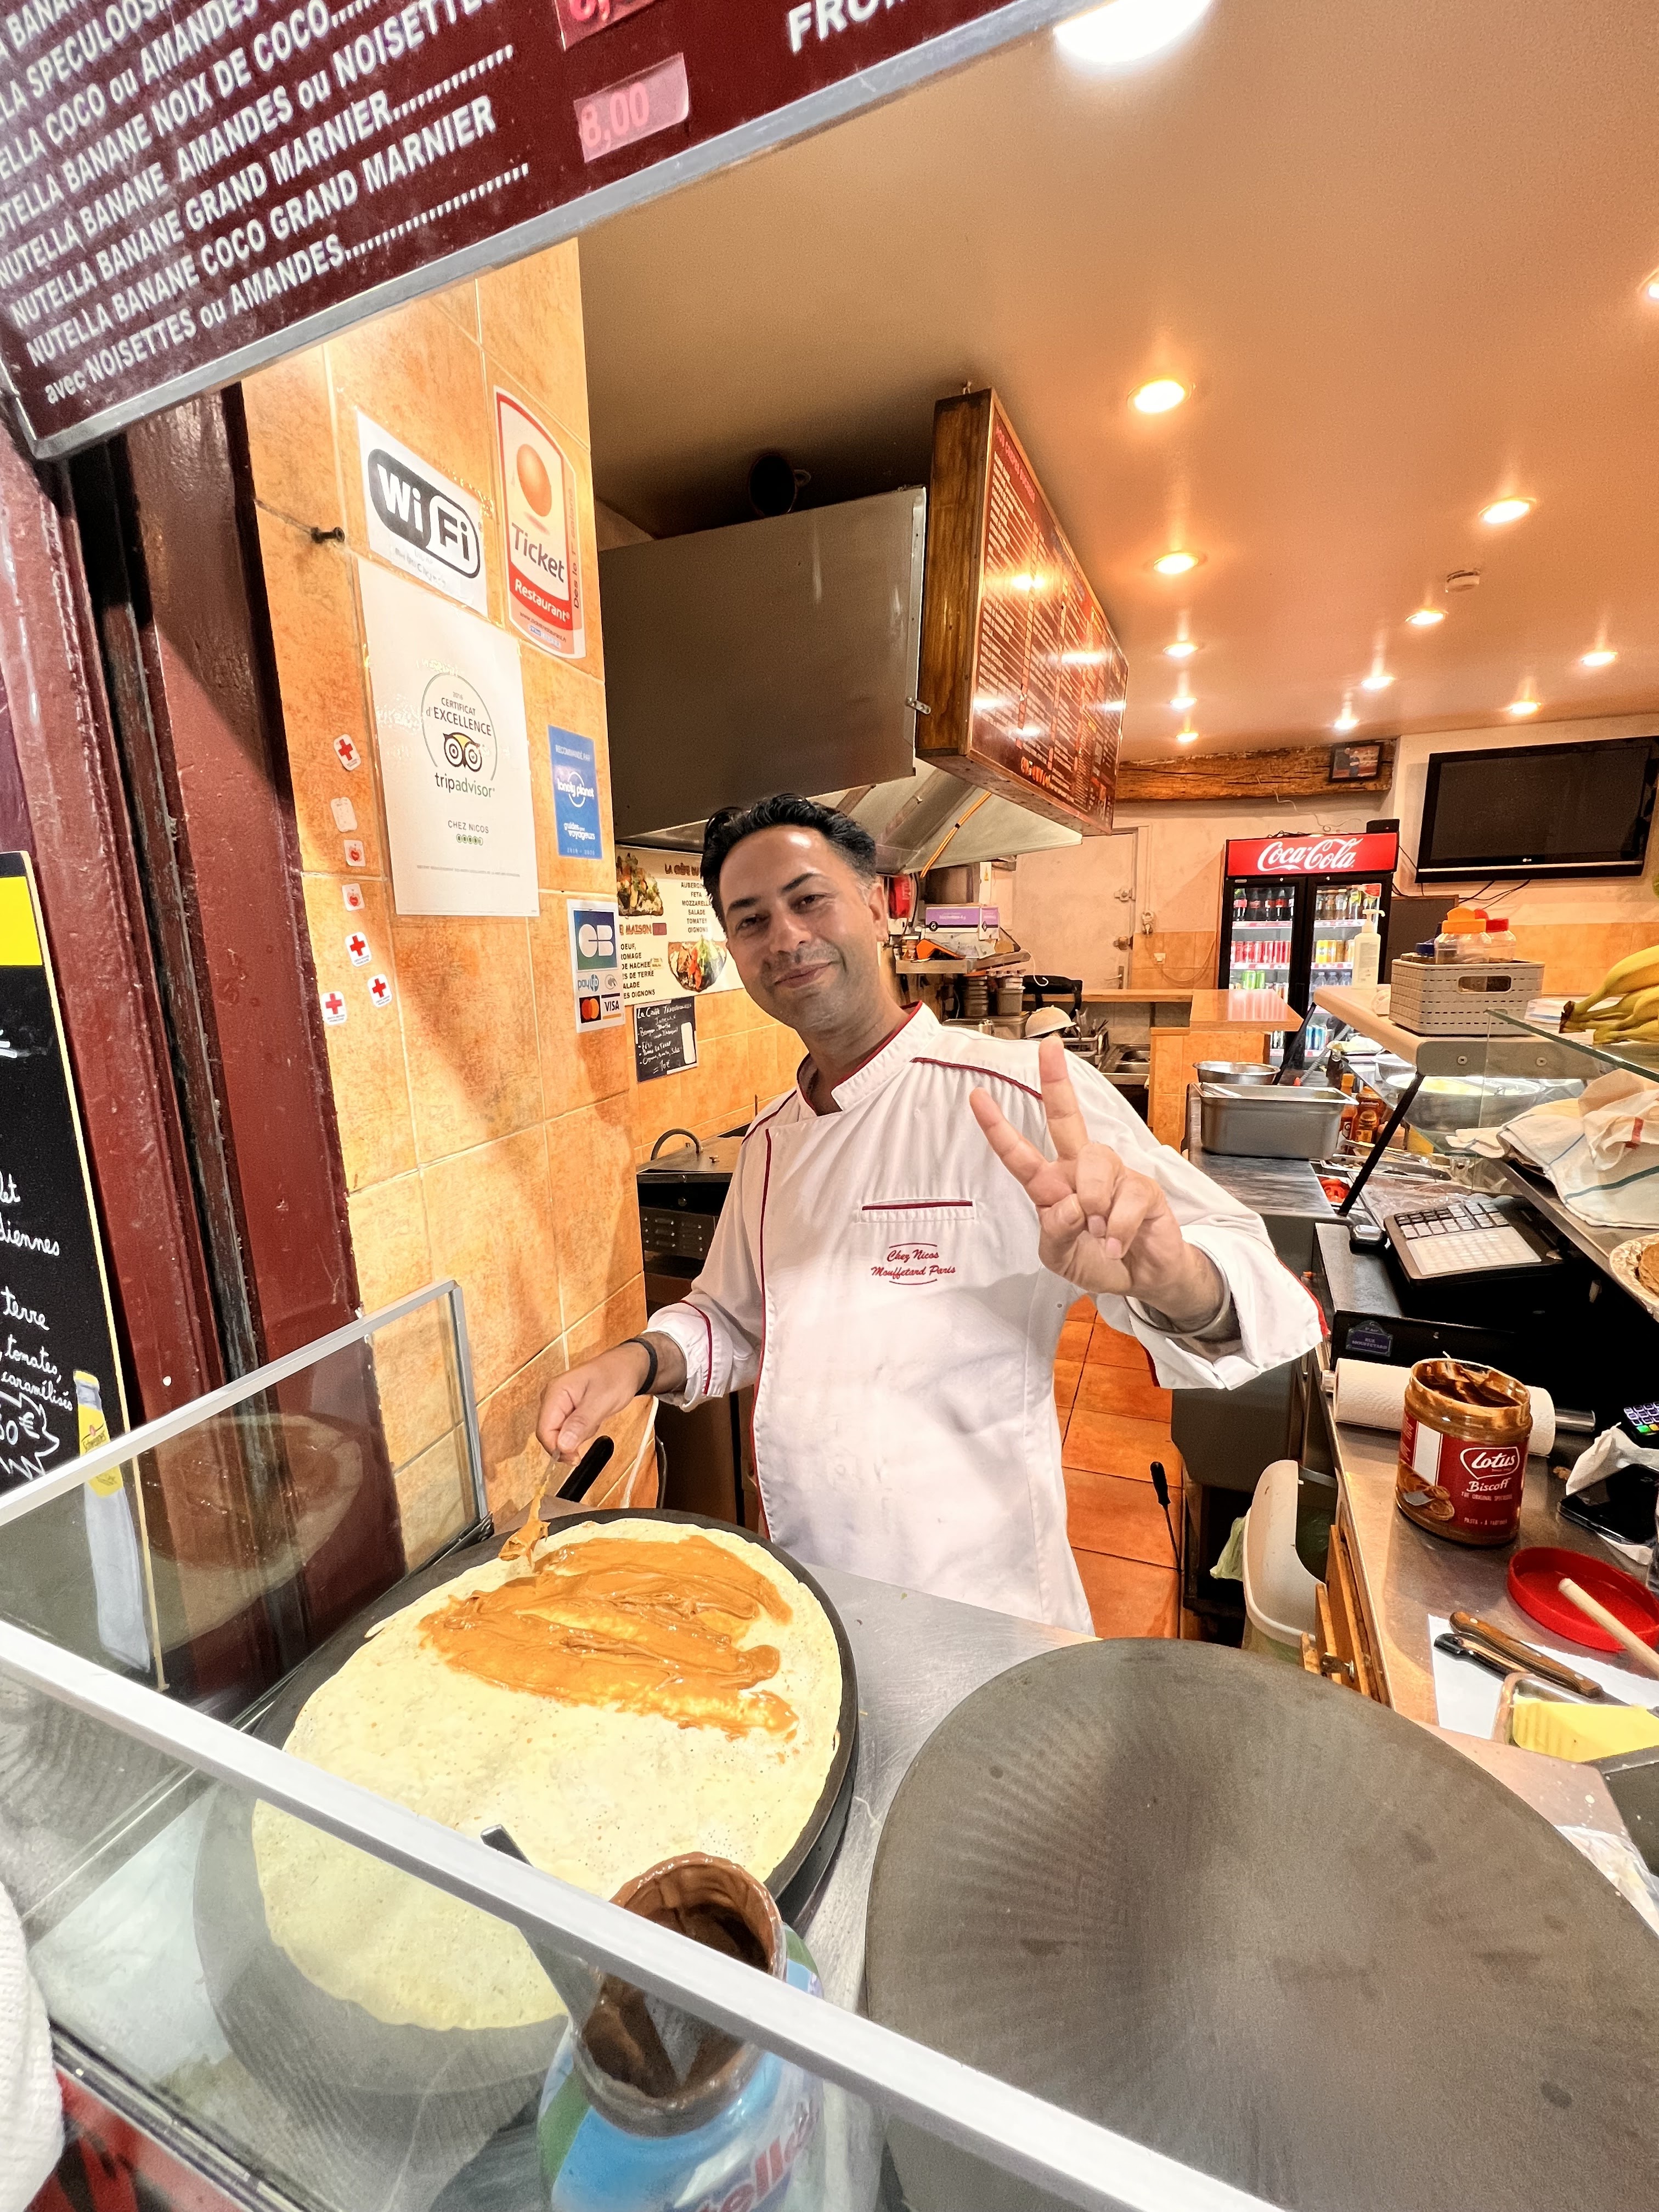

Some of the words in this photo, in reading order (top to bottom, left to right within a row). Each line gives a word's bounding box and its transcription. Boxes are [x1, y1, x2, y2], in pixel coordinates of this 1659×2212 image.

[46, 83, 107, 146] COCO
[110, 67, 138, 105] ou
[580, 81, 650, 151] 8,00
[61, 113, 153, 193] BANANE
[151, 72, 213, 137] NOIX
[213, 48, 252, 98] DE
[0, 218, 83, 289] NUTELLA
[79, 162, 168, 238] BANANE
[176, 85, 294, 182] AMANDES
[298, 70, 330, 110] ou
[26, 303, 114, 368] NUTELLA
[111, 255, 200, 323] BANANE
[200, 219, 267, 276] COCO
[269, 170, 359, 240] GRAND
[361, 95, 495, 194] MARNIER
[9, 261, 98, 329] NUTELLA
[97, 211, 185, 281] BANANE
[185, 162, 268, 232] GRAND
[44, 368, 87, 405] avec
[84, 309, 198, 385] NOISETTES
[199, 298, 227, 330] ou
[511, 522, 565, 584] Ticket
[441, 697, 476, 716] CERTIFICAT
[426, 706, 492, 736] d'EXCELLENCE
[435, 772, 493, 798] tripadvisor
[557, 777, 576, 798] lonely
[576, 783, 595, 799] planet
[448, 820, 467, 831] CHEZ
[469, 823, 489, 834] NICOS
[563, 821, 580, 831] guides
[568, 828, 596, 841] voyageurs
[1257, 837, 1364, 872] Coca-Cola
[625, 924, 652, 935] MAISON
[631, 989, 656, 998] OIGNONS
[603, 1000, 619, 1012] VISA
[887, 1249, 911, 1263] Chez
[912, 1249, 940, 1260] Nicos
[870, 1266, 926, 1280] Mouffetard
[928, 1265, 957, 1276] Paris
[0, 1286, 50, 1331] terre
[1471, 1452, 1516, 1469] Lotus
[1466, 1477, 1513, 1492] Biscoff
[1464, 1517, 1479, 1525] PASTA
